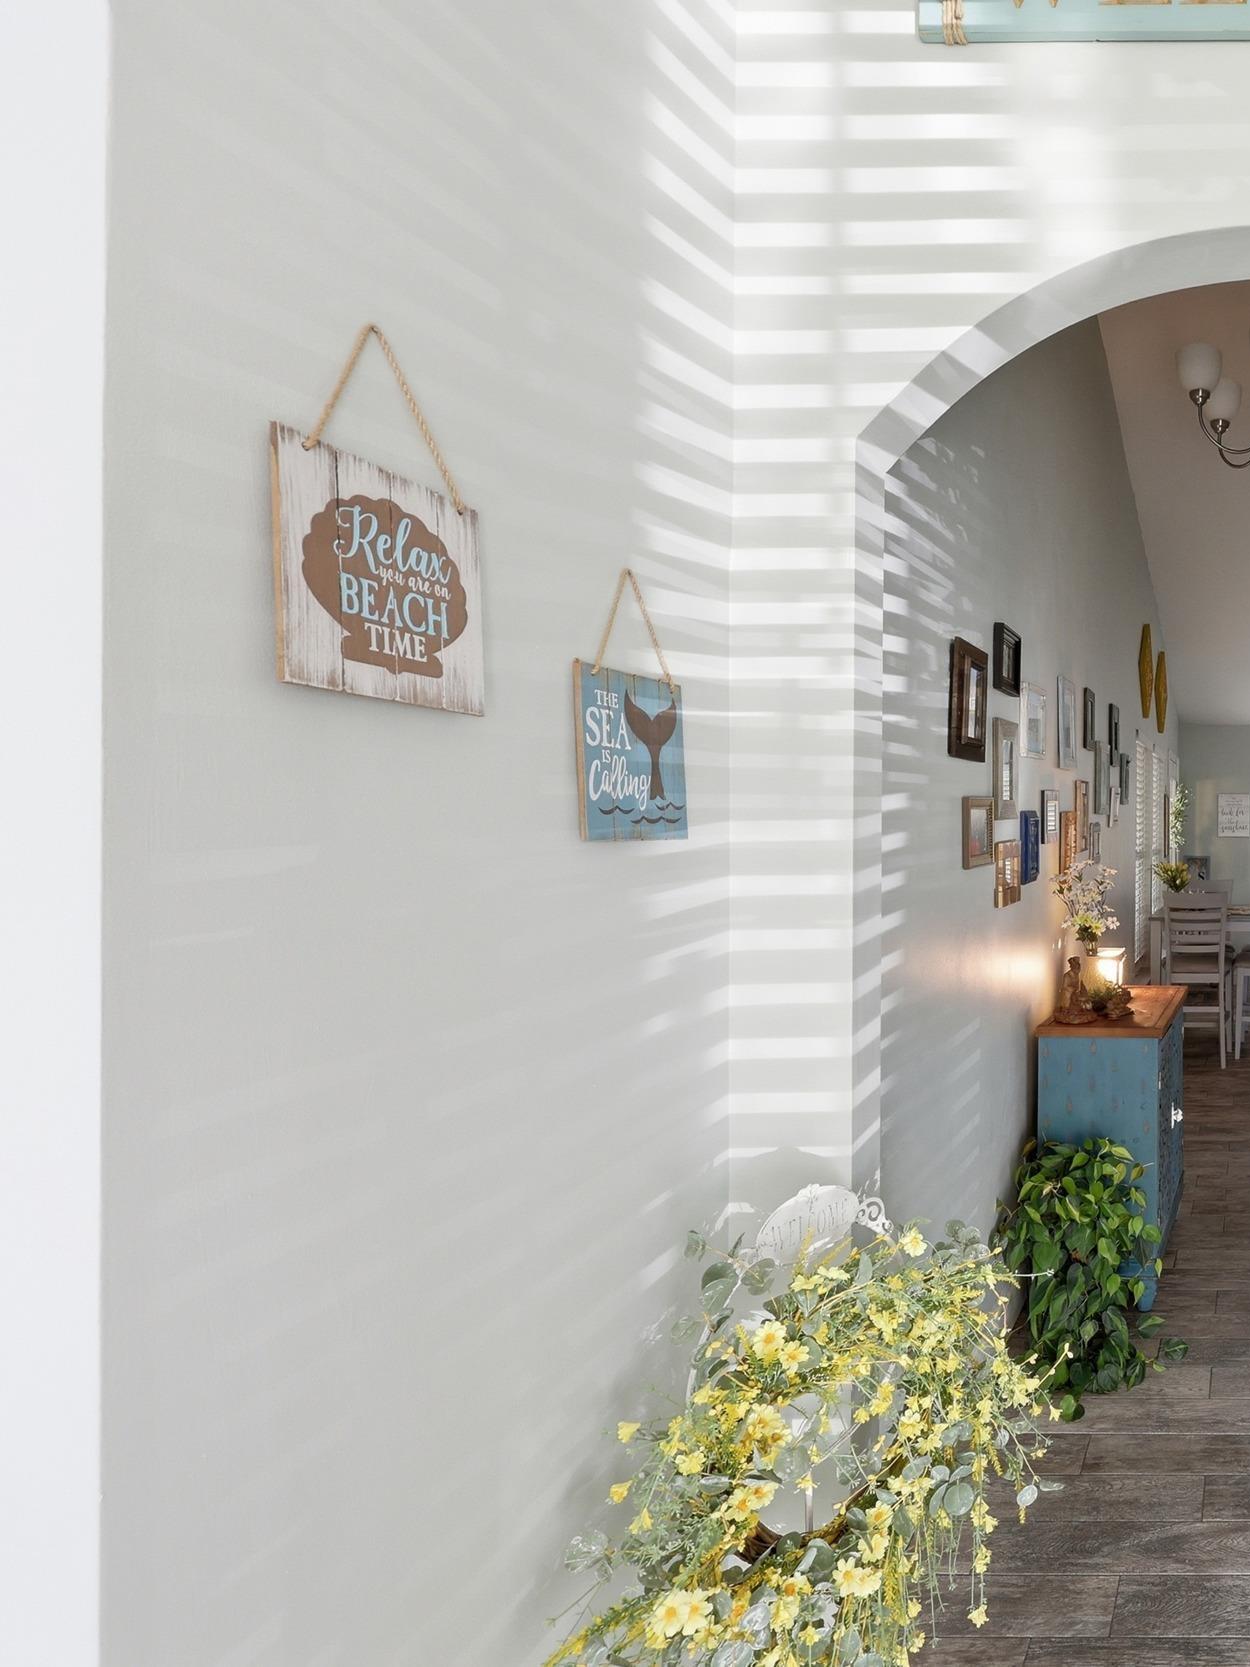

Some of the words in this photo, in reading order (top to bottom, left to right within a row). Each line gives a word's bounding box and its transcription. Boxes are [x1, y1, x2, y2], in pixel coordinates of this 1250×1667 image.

[333, 504, 452, 584] Relax
[379, 565, 405, 586] you
[408, 576, 432, 594] are
[434, 584, 452, 600] on
[340, 571, 449, 639] BEACH
[364, 622, 427, 662] TIME
[594, 689, 619, 709] THE
[585, 706, 632, 750] SEA
[602, 749, 611, 764] IS
[588, 755, 651, 811] Calling
